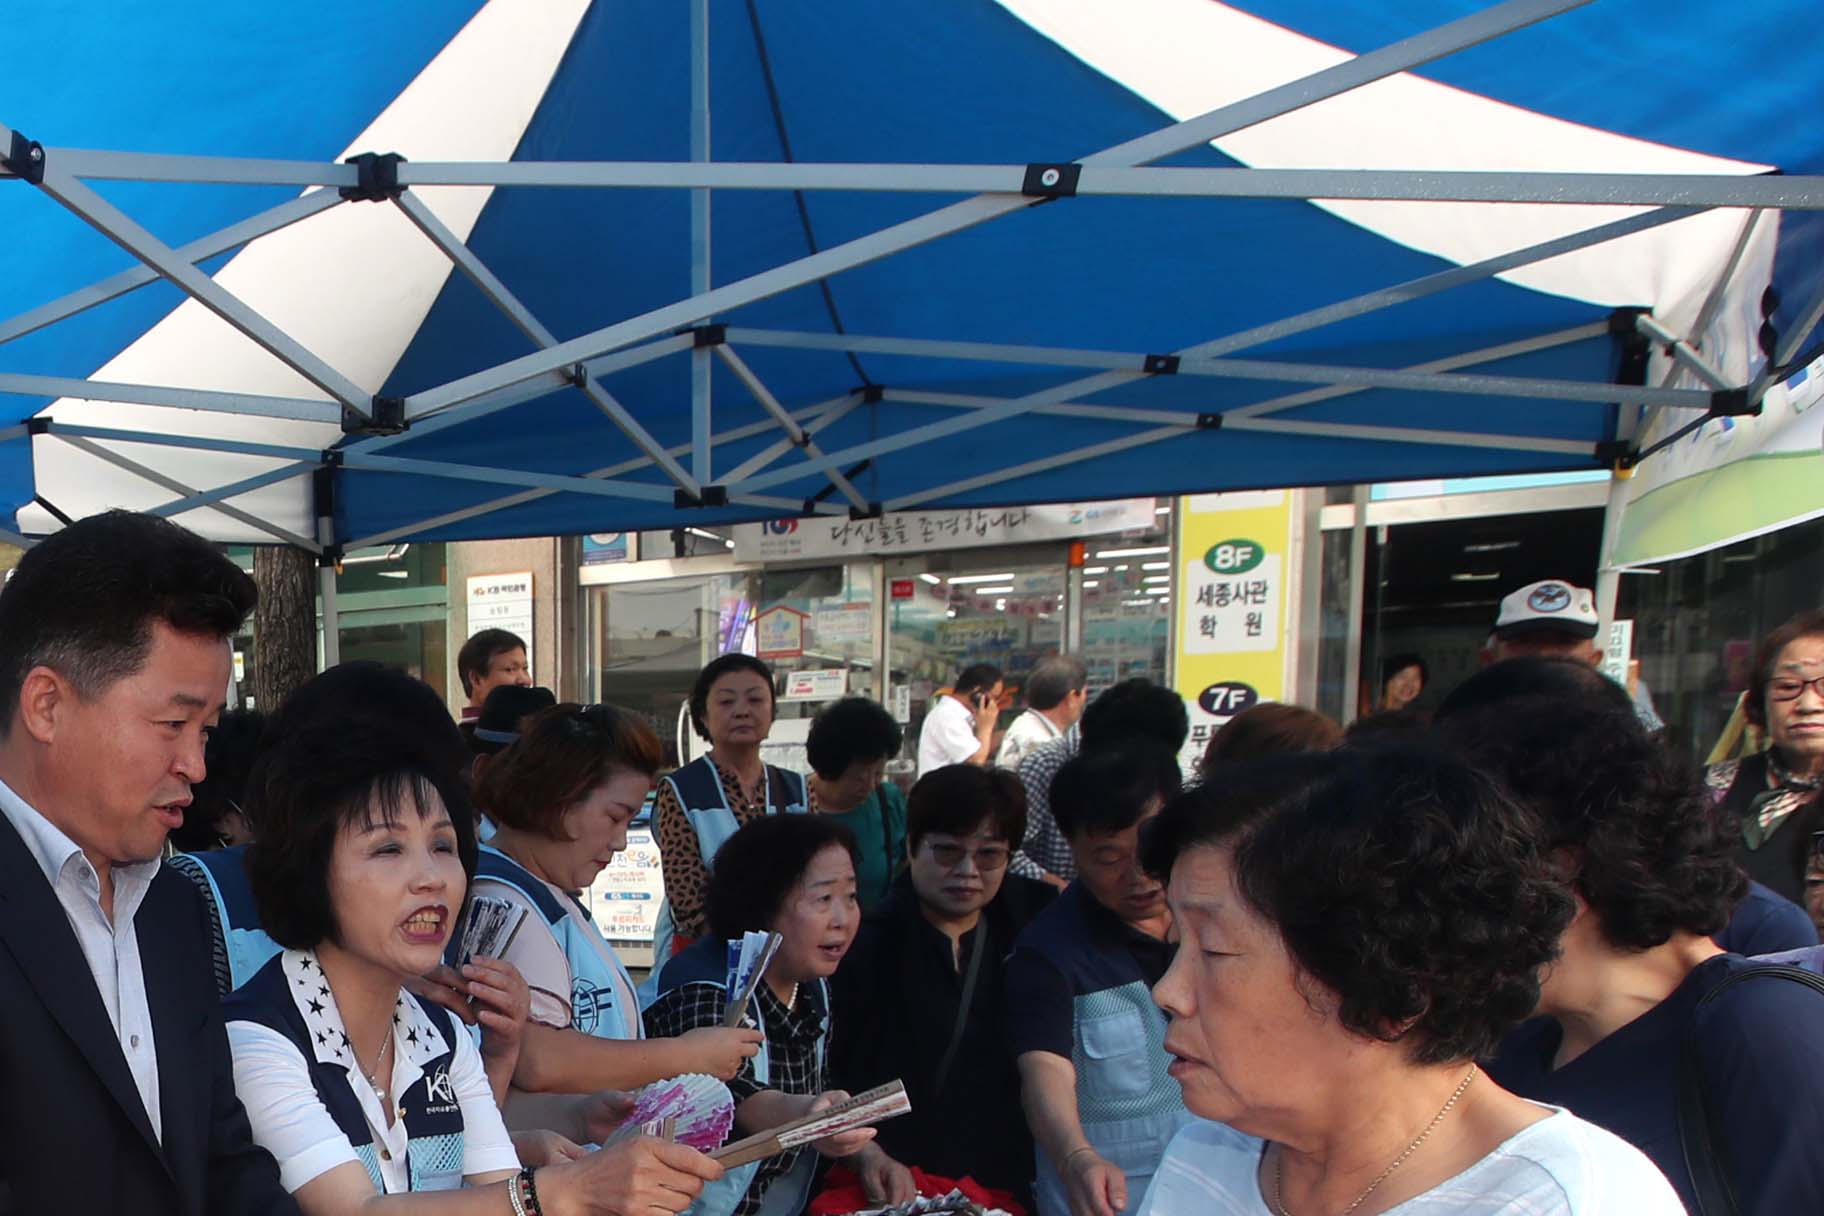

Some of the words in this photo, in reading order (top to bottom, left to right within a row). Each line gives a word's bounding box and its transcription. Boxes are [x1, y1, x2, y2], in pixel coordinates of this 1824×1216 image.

[919, 510, 1032, 545] 존경합니다
[1213, 544, 1253, 570] 8F
[1195, 579, 1269, 608] 세종사관
[1208, 687, 1247, 711] 7F
